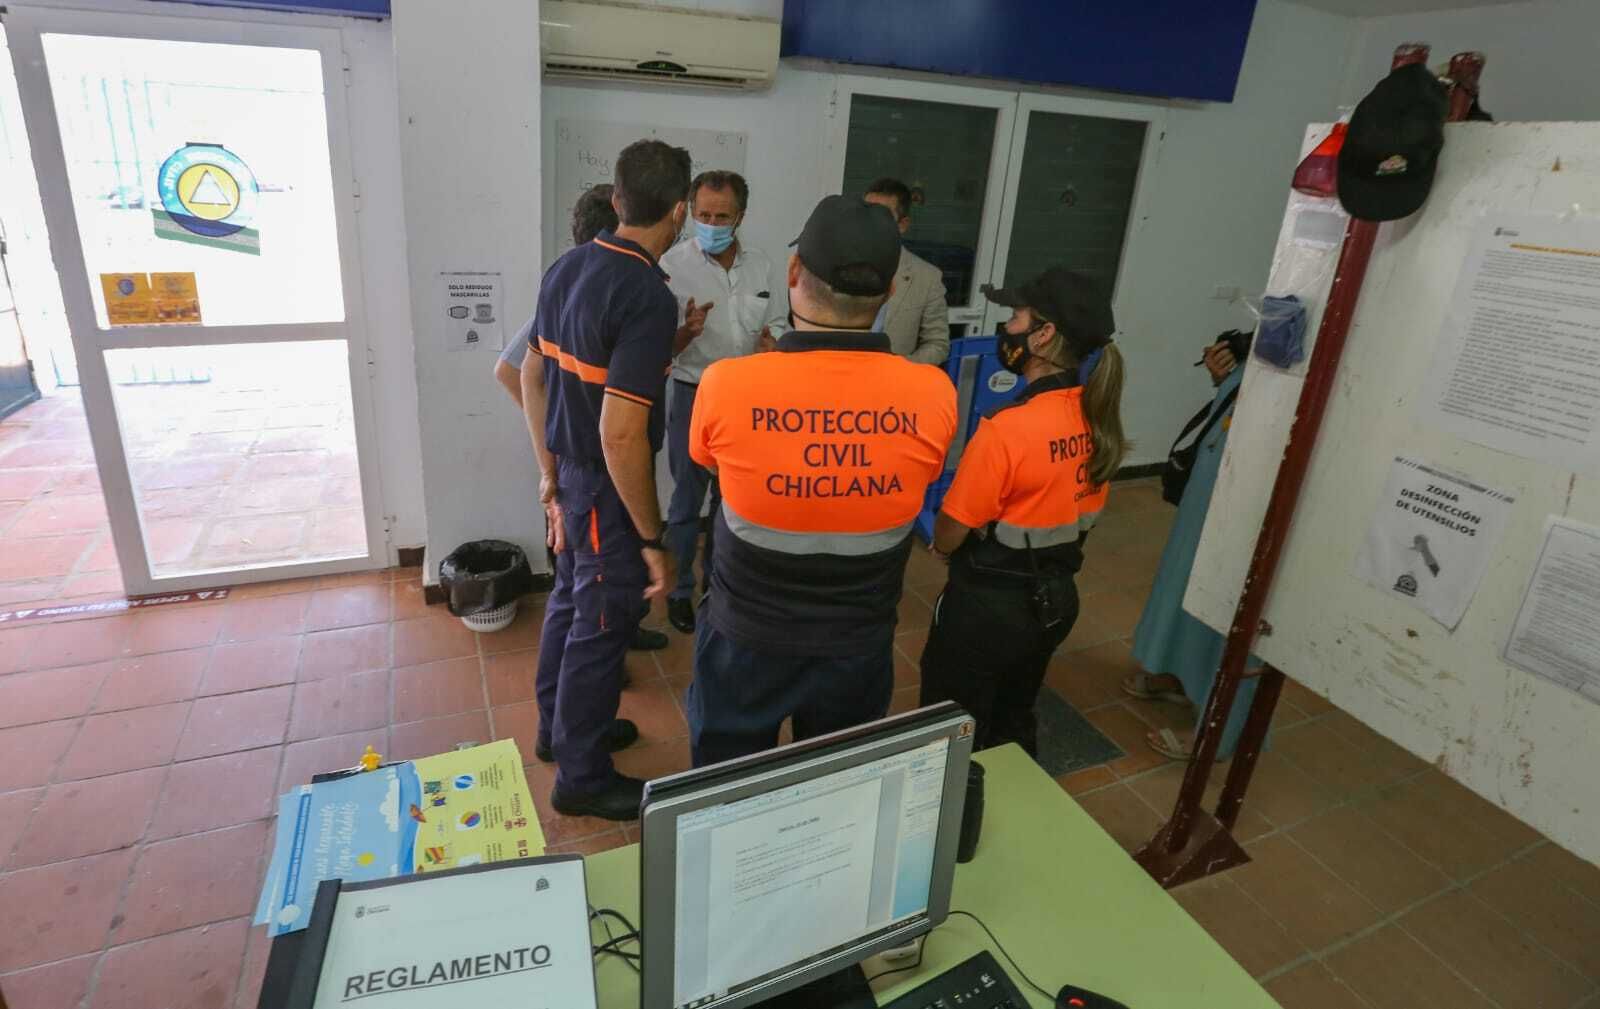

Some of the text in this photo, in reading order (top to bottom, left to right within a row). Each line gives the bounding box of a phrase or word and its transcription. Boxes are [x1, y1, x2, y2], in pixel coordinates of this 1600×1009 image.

[751, 406, 918, 435] PROTECCIÓN
[803, 443, 872, 467] CIVIL
[1049, 432, 1093, 463] PROTE
[766, 473, 904, 498] CHICLANA
[1426, 484, 1459, 502] ZONA
[1395, 500, 1477, 536] DE UTENSILIOS
[1400, 488, 1481, 525] DESINFECCIÓN
[344, 944, 552, 998] REGLAMENTO
